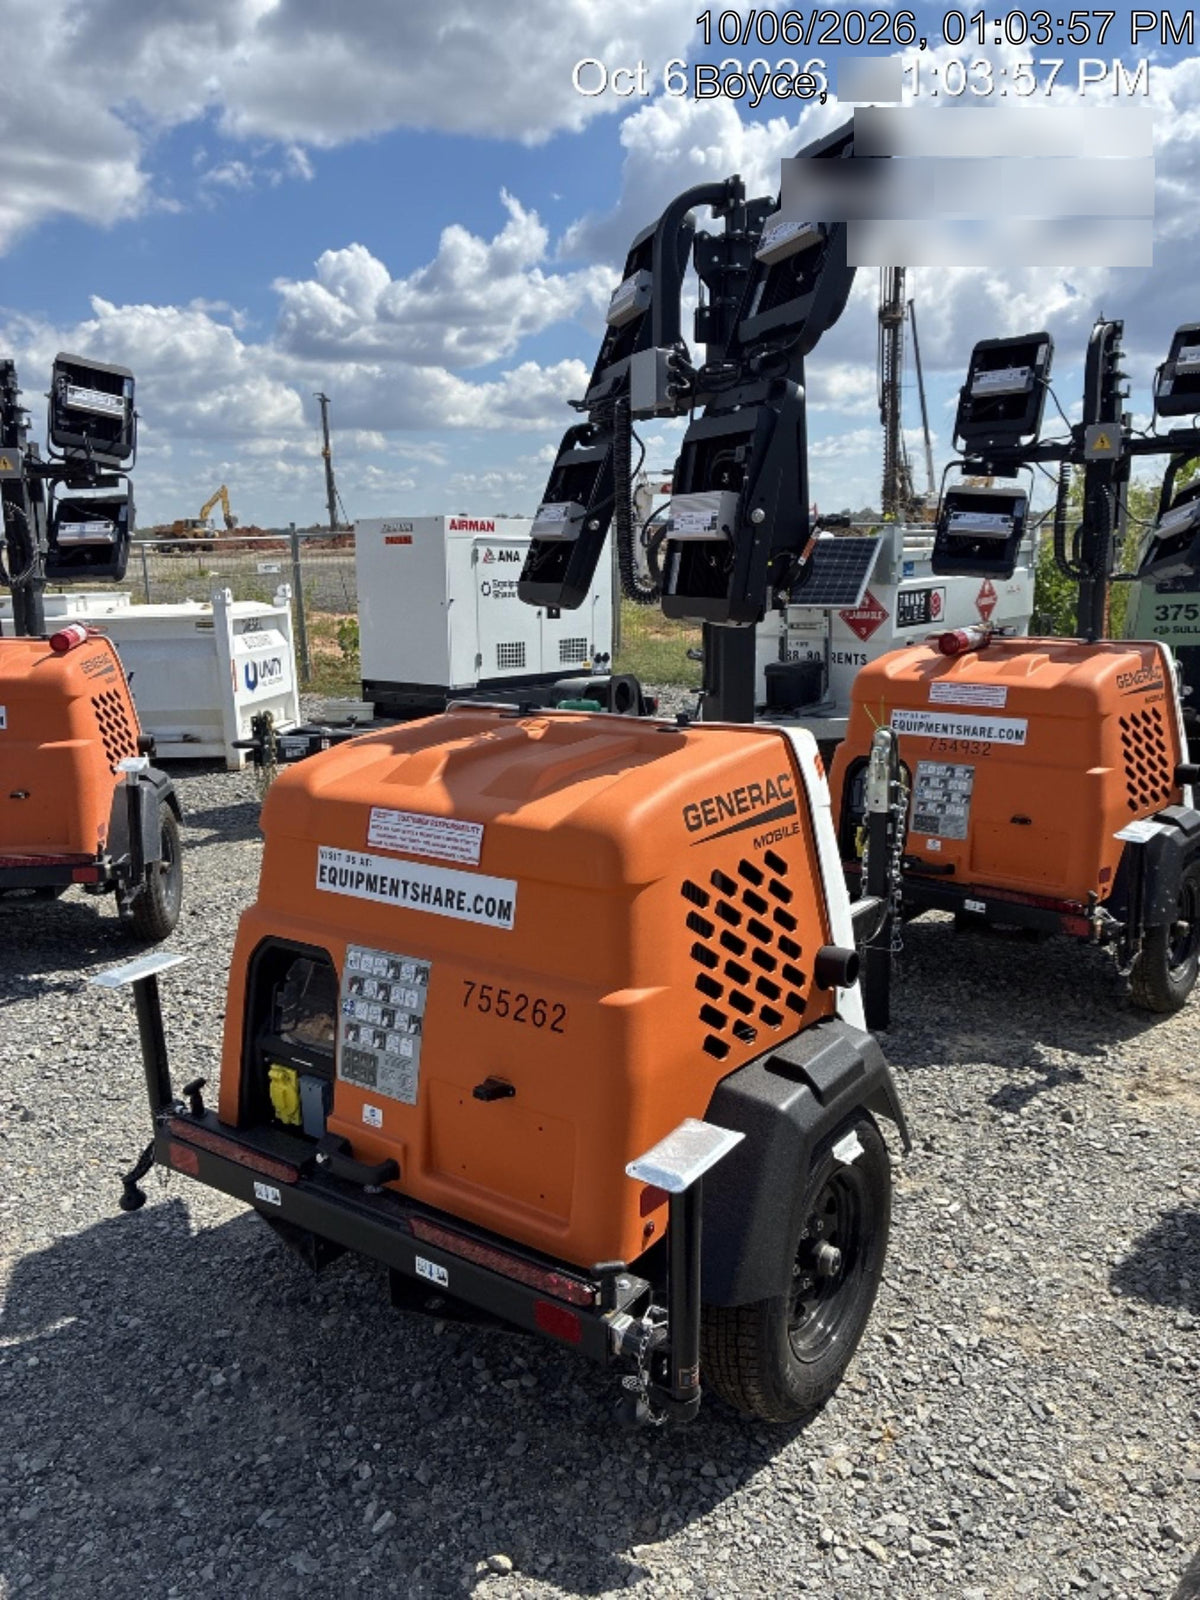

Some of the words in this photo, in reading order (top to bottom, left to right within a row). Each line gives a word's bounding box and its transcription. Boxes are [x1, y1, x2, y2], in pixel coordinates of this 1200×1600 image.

[449, 519, 496, 532] AIRMAN
[498, 550, 521, 562] ANA
[492, 579, 520, 590] Equip
[1155, 604, 1200, 621] 375
[892, 719, 1025, 740] EQUIPMENTSHARE.COM
[682, 772, 794, 832] GENERAC
[753, 821, 801, 850] MOBILE
[320, 850, 342, 861] VISIT
[318, 864, 512, 922] EQUIPMENTSHARE.COM
[463, 980, 566, 1033] 755262
